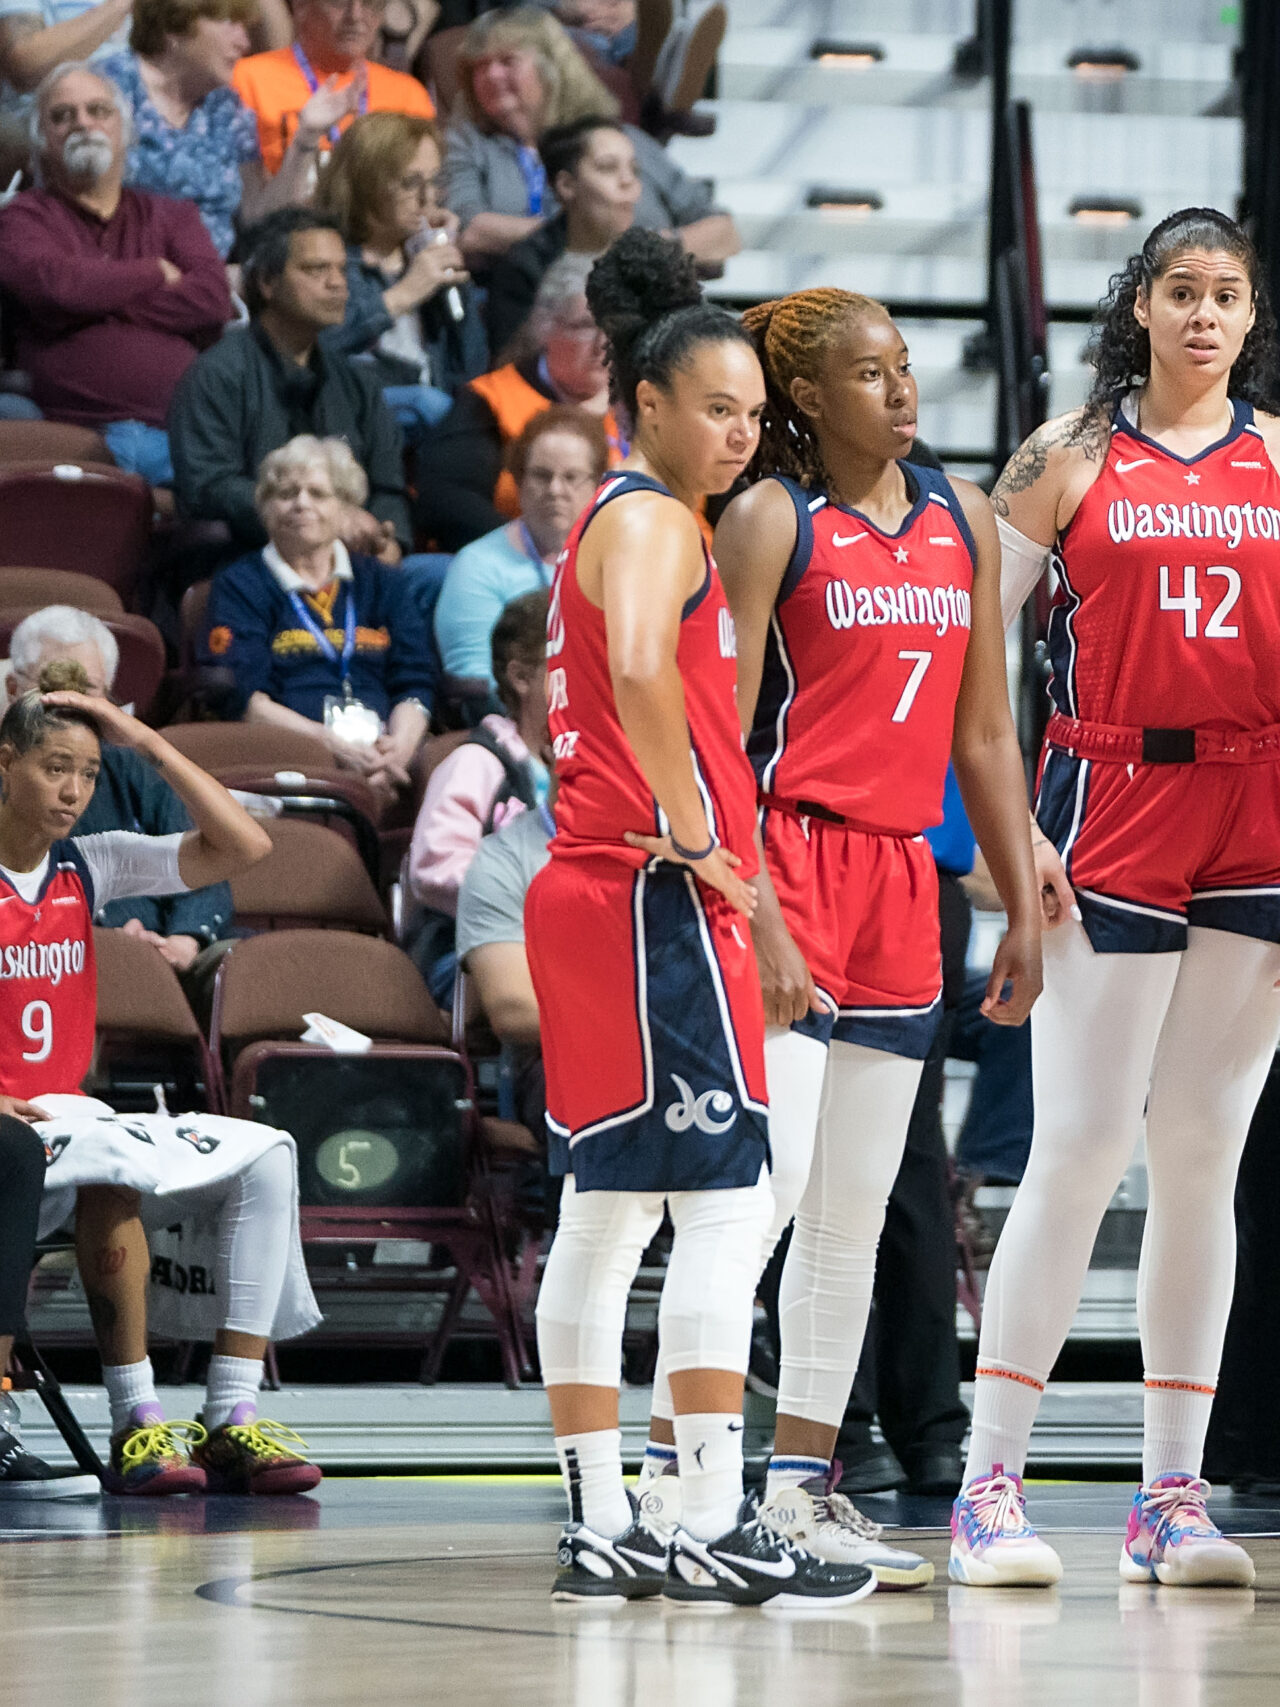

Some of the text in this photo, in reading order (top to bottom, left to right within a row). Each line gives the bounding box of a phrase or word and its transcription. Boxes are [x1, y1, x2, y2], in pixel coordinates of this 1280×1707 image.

[825, 578, 972, 637] Washington
[1159, 565, 1242, 638] 42
[890, 650, 933, 723] 7
[21, 999, 53, 1063] 9
[338, 1140, 371, 1189] 5
